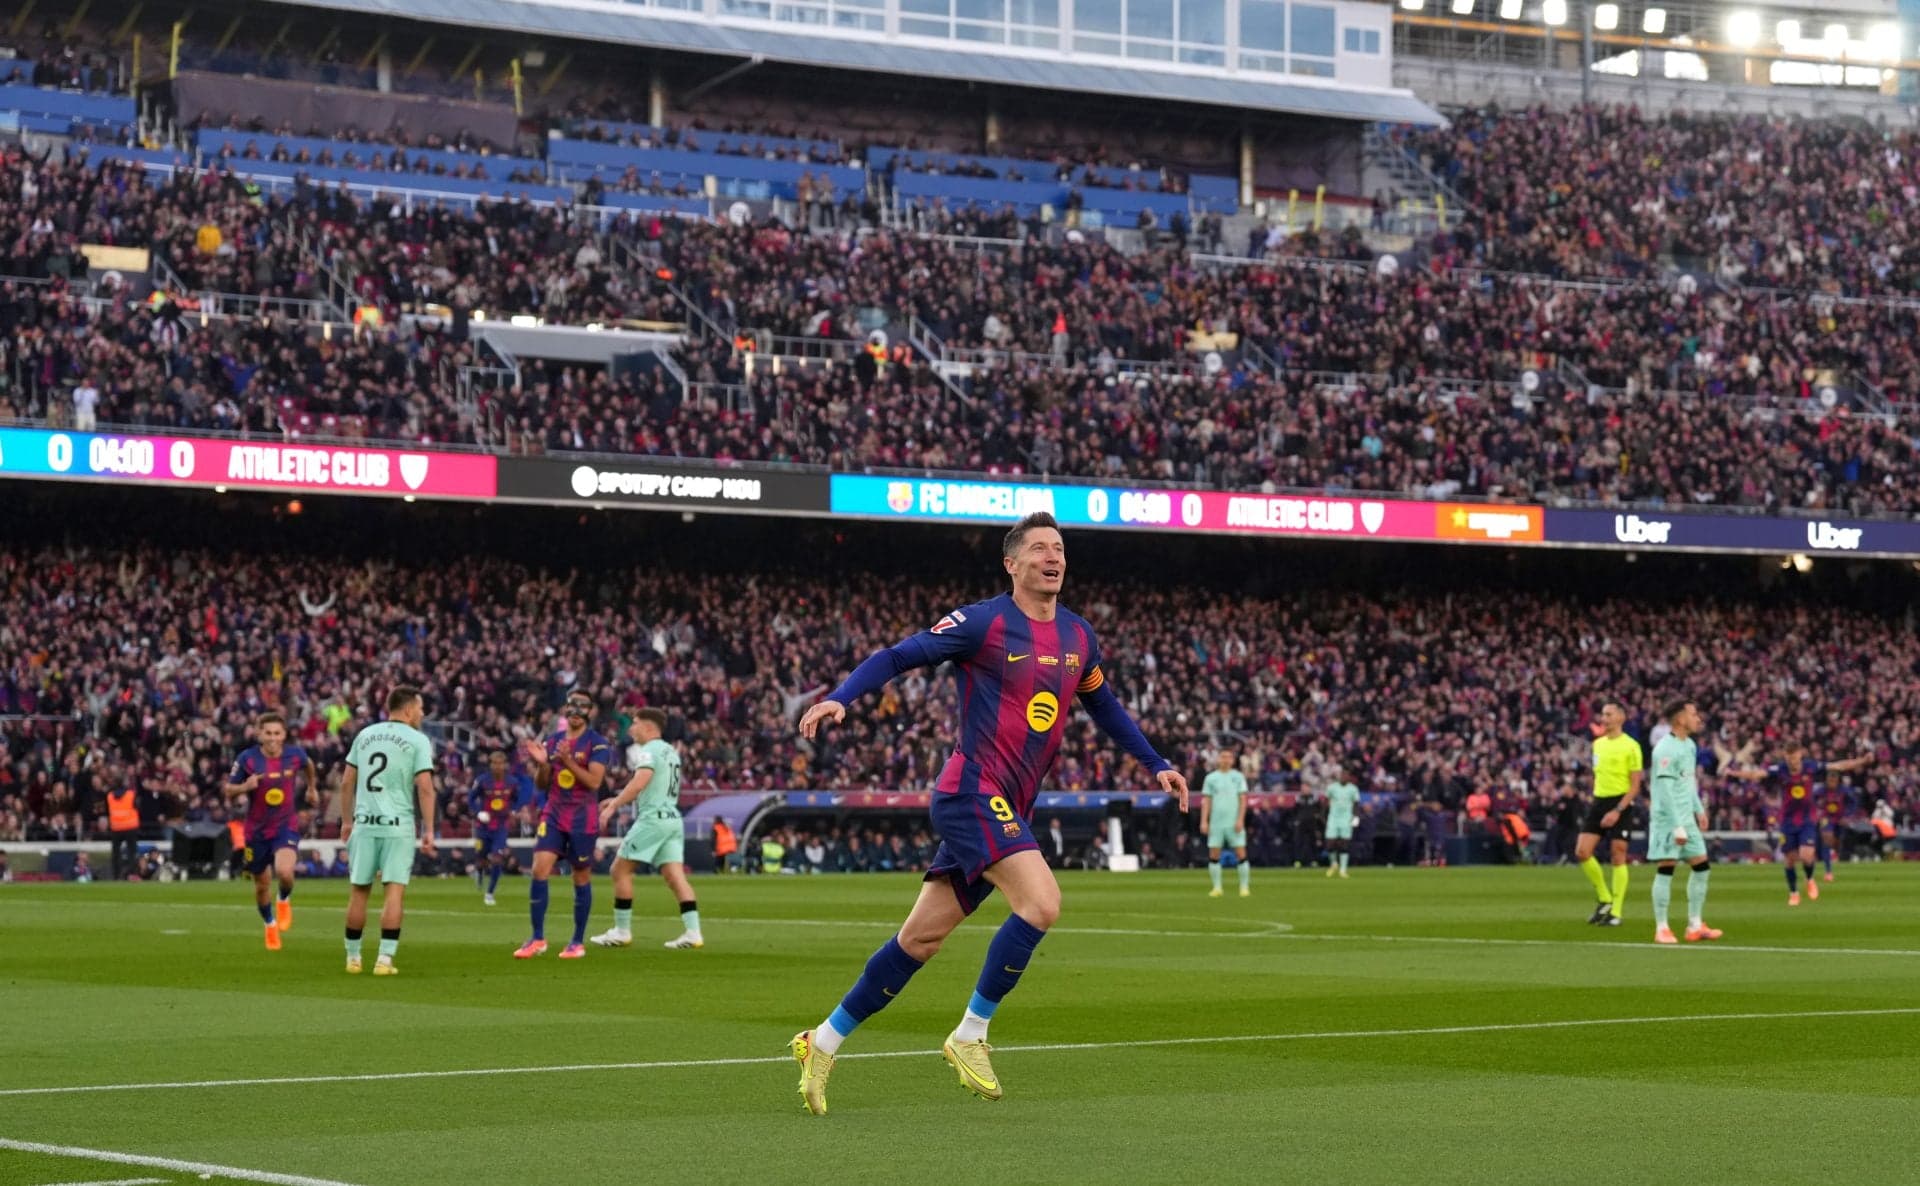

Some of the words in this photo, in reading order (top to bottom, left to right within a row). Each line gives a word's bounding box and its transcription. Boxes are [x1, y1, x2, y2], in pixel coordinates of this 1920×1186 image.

[49, 434, 72, 471] 0
[90, 438, 153, 474] 04:00
[170, 441, 194, 477] 0
[228, 446, 329, 483] ATHLETIC
[332, 452, 389, 486] CLUB
[598, 472, 671, 495] SPOTIFY
[671, 476, 722, 497] CAMP
[723, 479, 760, 499] NOU
[920, 483, 945, 513] FC
[947, 485, 1054, 518] BARCELONA
[1088, 490, 1107, 521] 0
[1182, 494, 1202, 525] 0
[1227, 498, 1307, 528] ATHLETIC
[1307, 501, 1353, 530] CLUB
[1616, 515, 1671, 543] Uber
[1808, 522, 1862, 549] Uber
[366, 751, 388, 792] 2
[989, 796, 1014, 821] 9
